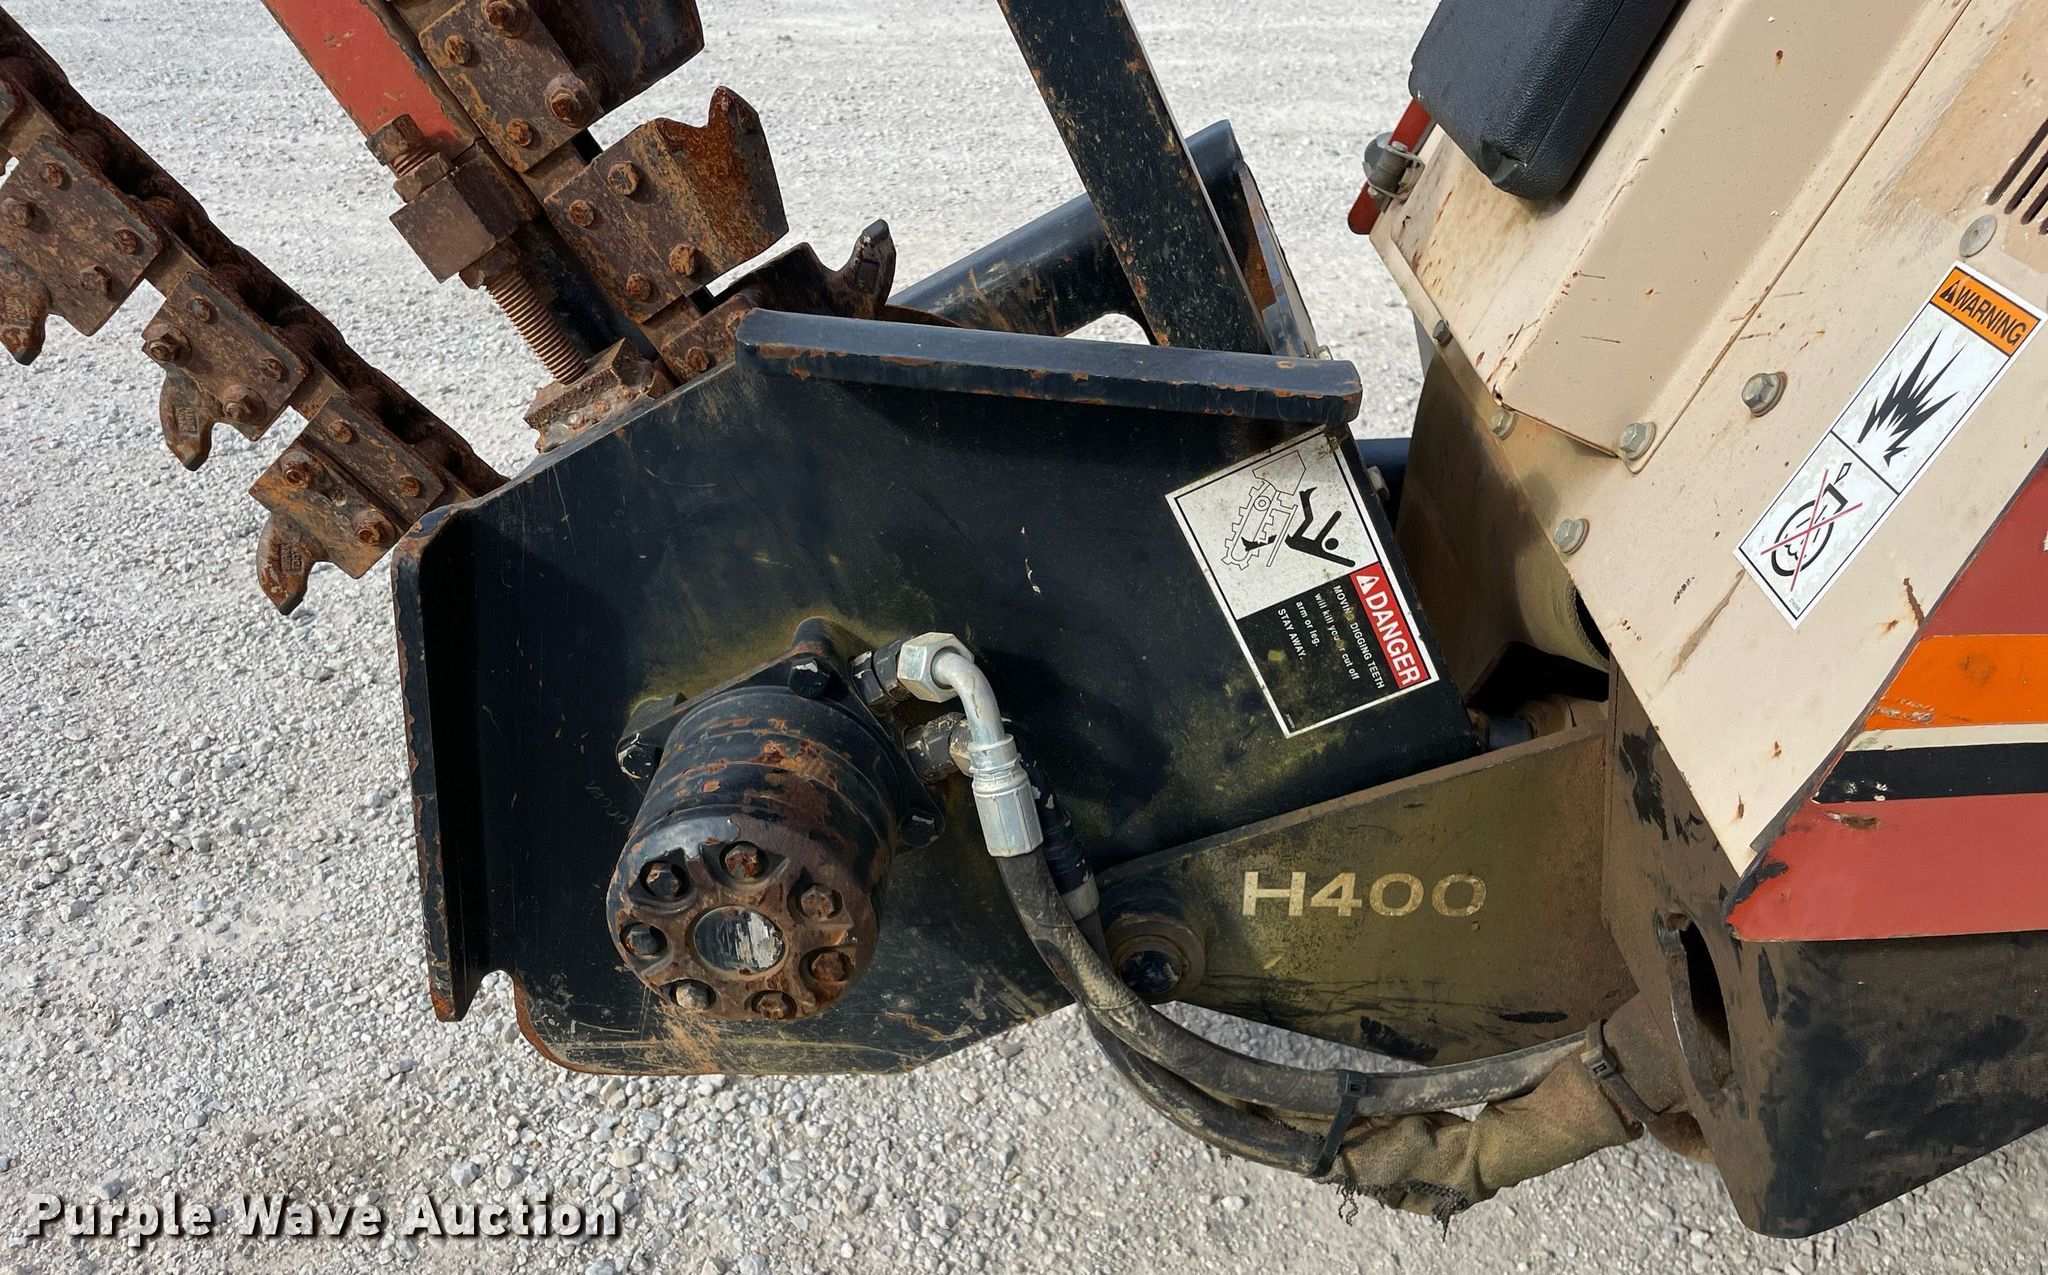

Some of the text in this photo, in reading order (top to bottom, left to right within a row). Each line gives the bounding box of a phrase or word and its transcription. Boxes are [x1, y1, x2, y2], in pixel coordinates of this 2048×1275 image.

[1955, 283, 2026, 346] WARNING
[1314, 592, 1327, 609] will
[1321, 609, 1333, 624] kill
[1277, 607, 1307, 660] STAY AWAY.
[1295, 600, 1322, 647] arm or leg.
[1326, 624, 1341, 642] you
[1333, 585, 1385, 689] MOVING DIGGING TEETH
[1367, 591, 1420, 686] DANGER
[1341, 652, 1353, 666] cut
[1348, 666, 1360, 680] off
[1242, 871, 1487, 916] H400
